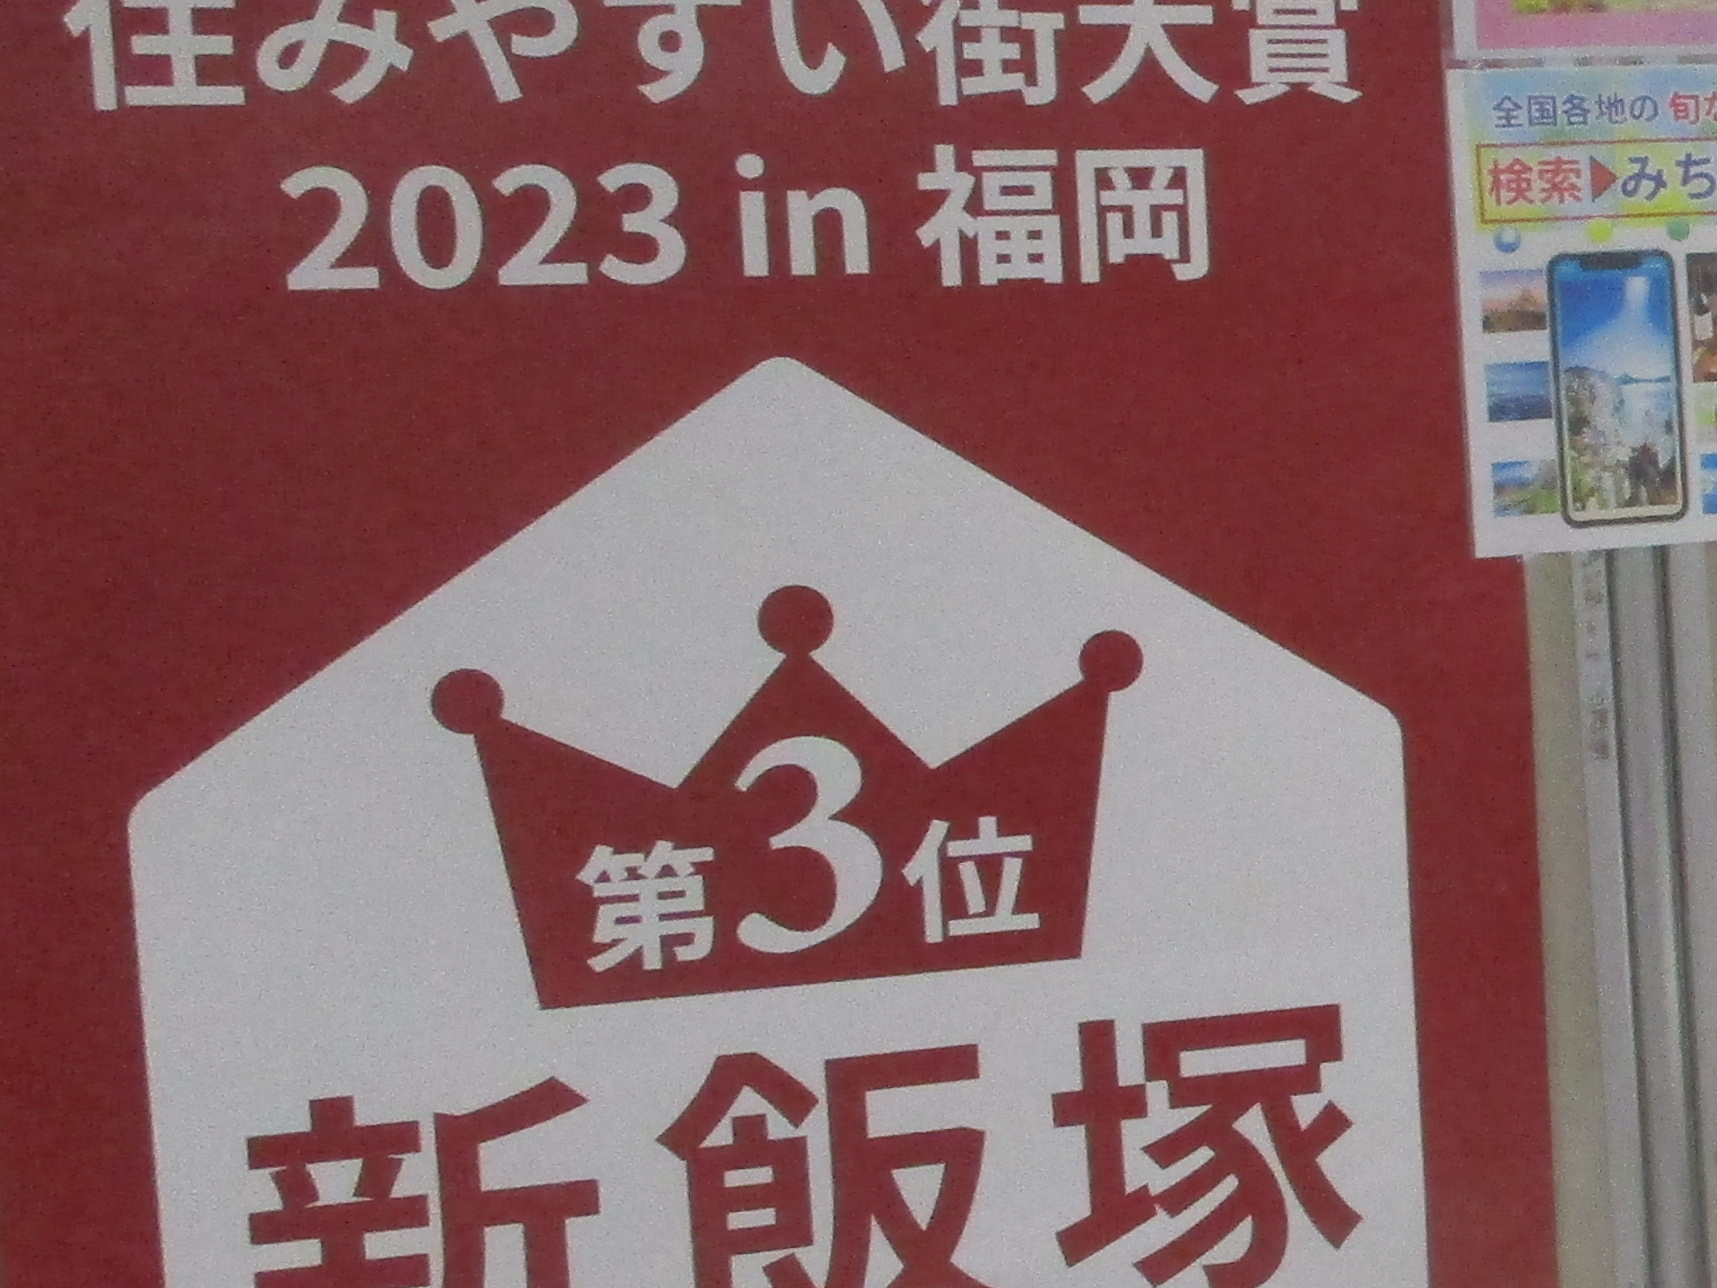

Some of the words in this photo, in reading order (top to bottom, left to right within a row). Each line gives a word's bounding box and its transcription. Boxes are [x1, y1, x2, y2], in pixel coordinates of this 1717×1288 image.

[279, 159, 689, 291] 2023
[734, 152, 872, 278] in
[913, 143, 1213, 288] 福岡
[1487, 157, 1584, 208] 検索
[576, 734, 1043, 976] 第3位
